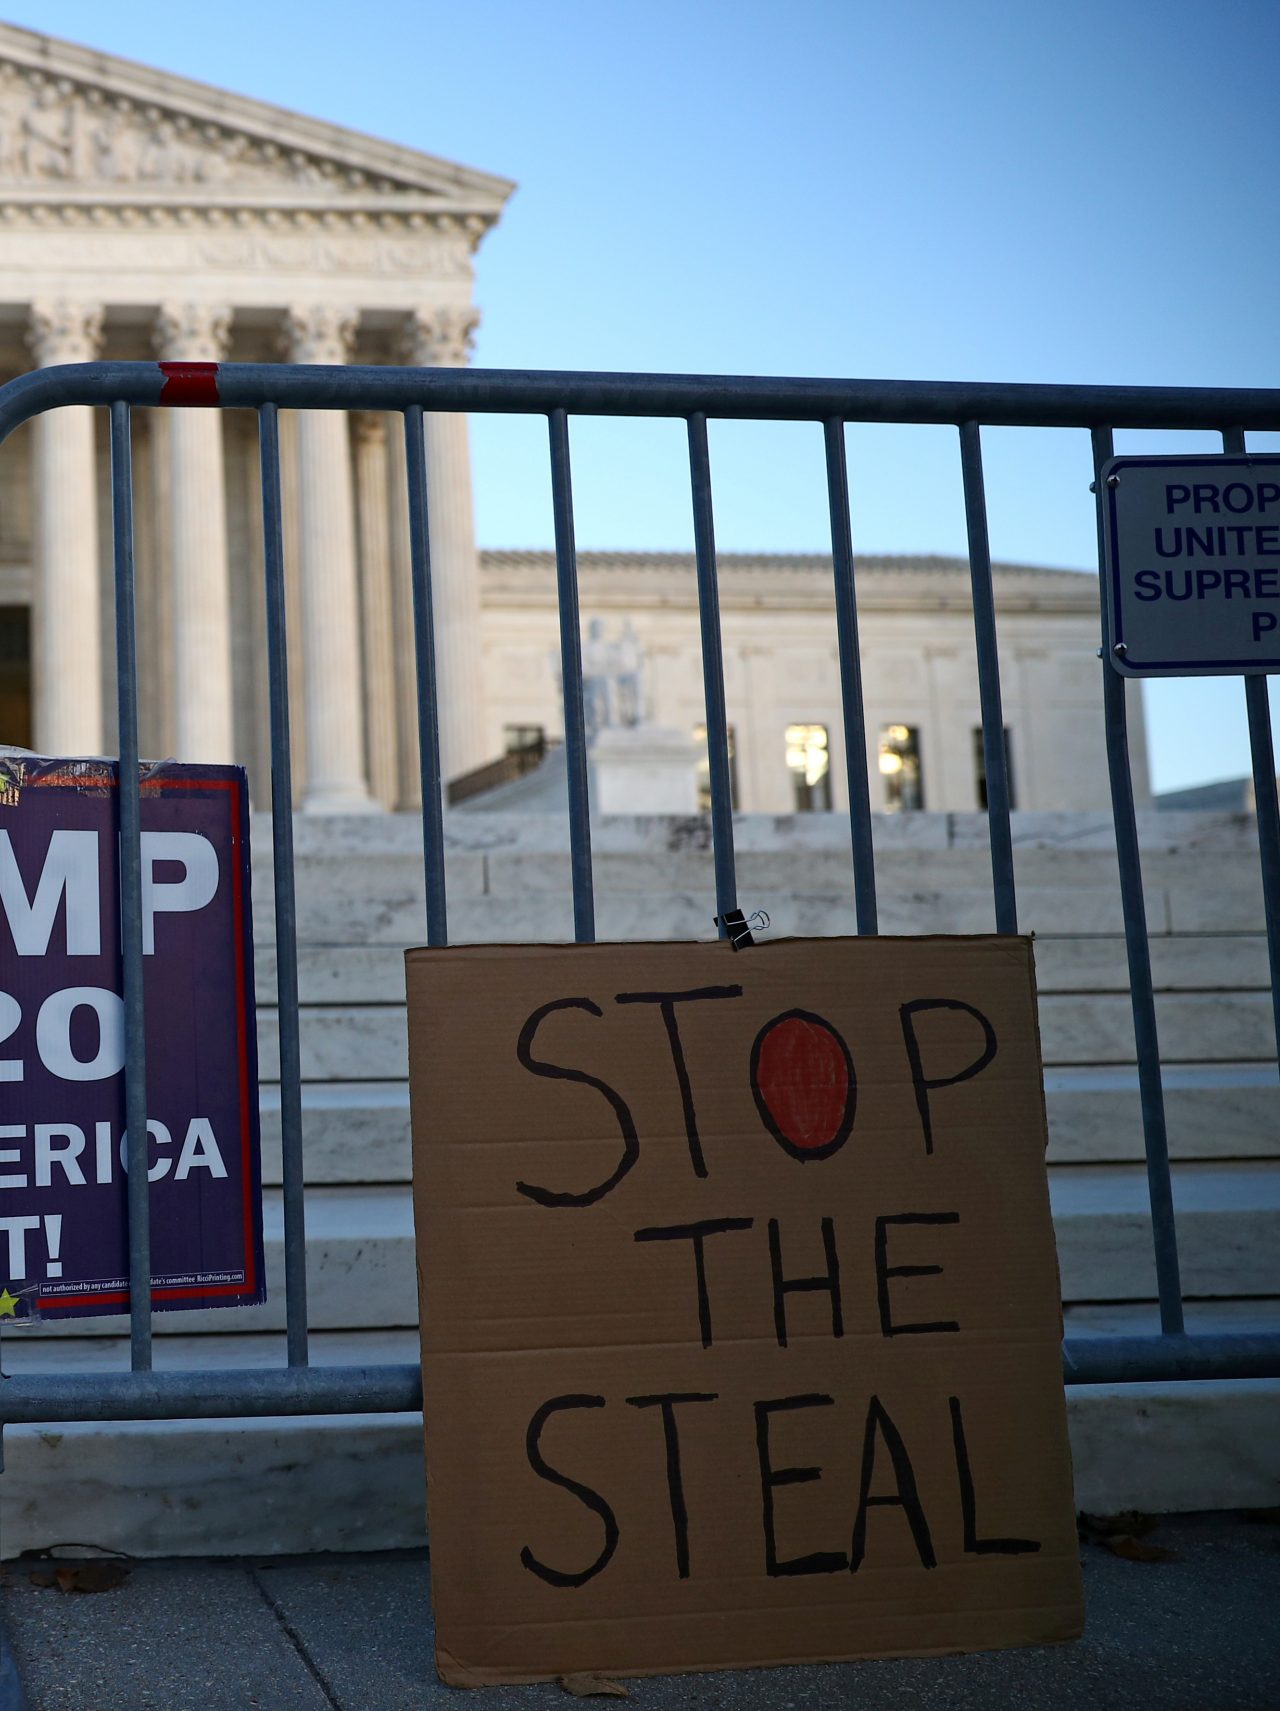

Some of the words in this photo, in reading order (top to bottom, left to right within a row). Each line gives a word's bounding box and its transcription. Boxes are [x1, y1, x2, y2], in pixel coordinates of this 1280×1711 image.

[1165, 482, 1280, 515] PROP
[1154, 525, 1280, 558] UNITE
[1133, 568, 1280, 602] SUPRE
[1251, 611, 1278, 642] P
[516, 984, 999, 1208] STOP
[42, 1285, 53, 1293] not
[53, 1282, 83, 1292] authorized
[83, 1283, 91, 1291] by
[91, 1282, 101, 1291] any
[101, 1280, 129, 1290] candidate
[166, 1275, 196, 1285] committee
[633, 1211, 961, 1349] THE
[520, 1393, 1043, 1588] STEAL
